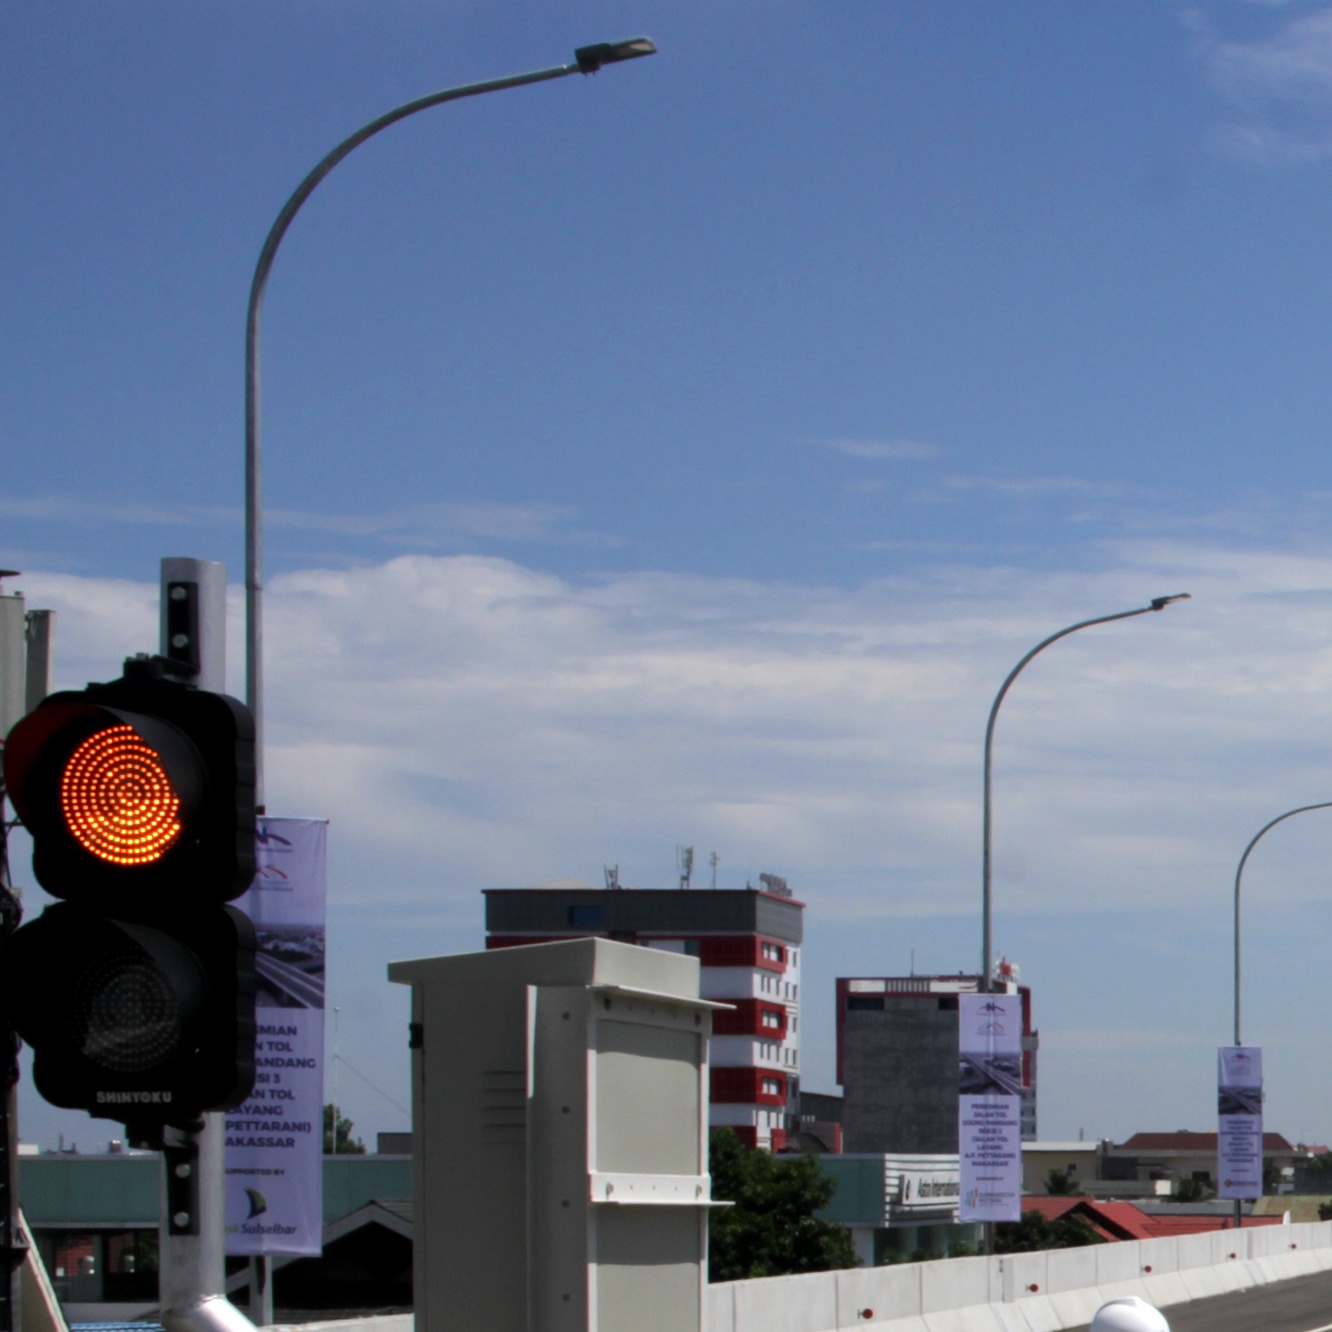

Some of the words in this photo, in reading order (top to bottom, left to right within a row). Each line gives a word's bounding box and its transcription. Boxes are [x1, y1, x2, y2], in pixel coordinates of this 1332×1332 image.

[267, 1042, 293, 1052] TOL
[256, 1058, 317, 1069] ANDANG
[274, 1074, 281, 1084] 3
[96, 1091, 173, 1104] SHINYOKU
[268, 1090, 295, 1100] TOL
[225, 1137, 295, 1148] AKASSAR
[241, 1223, 297, 1235] Sulselbar
